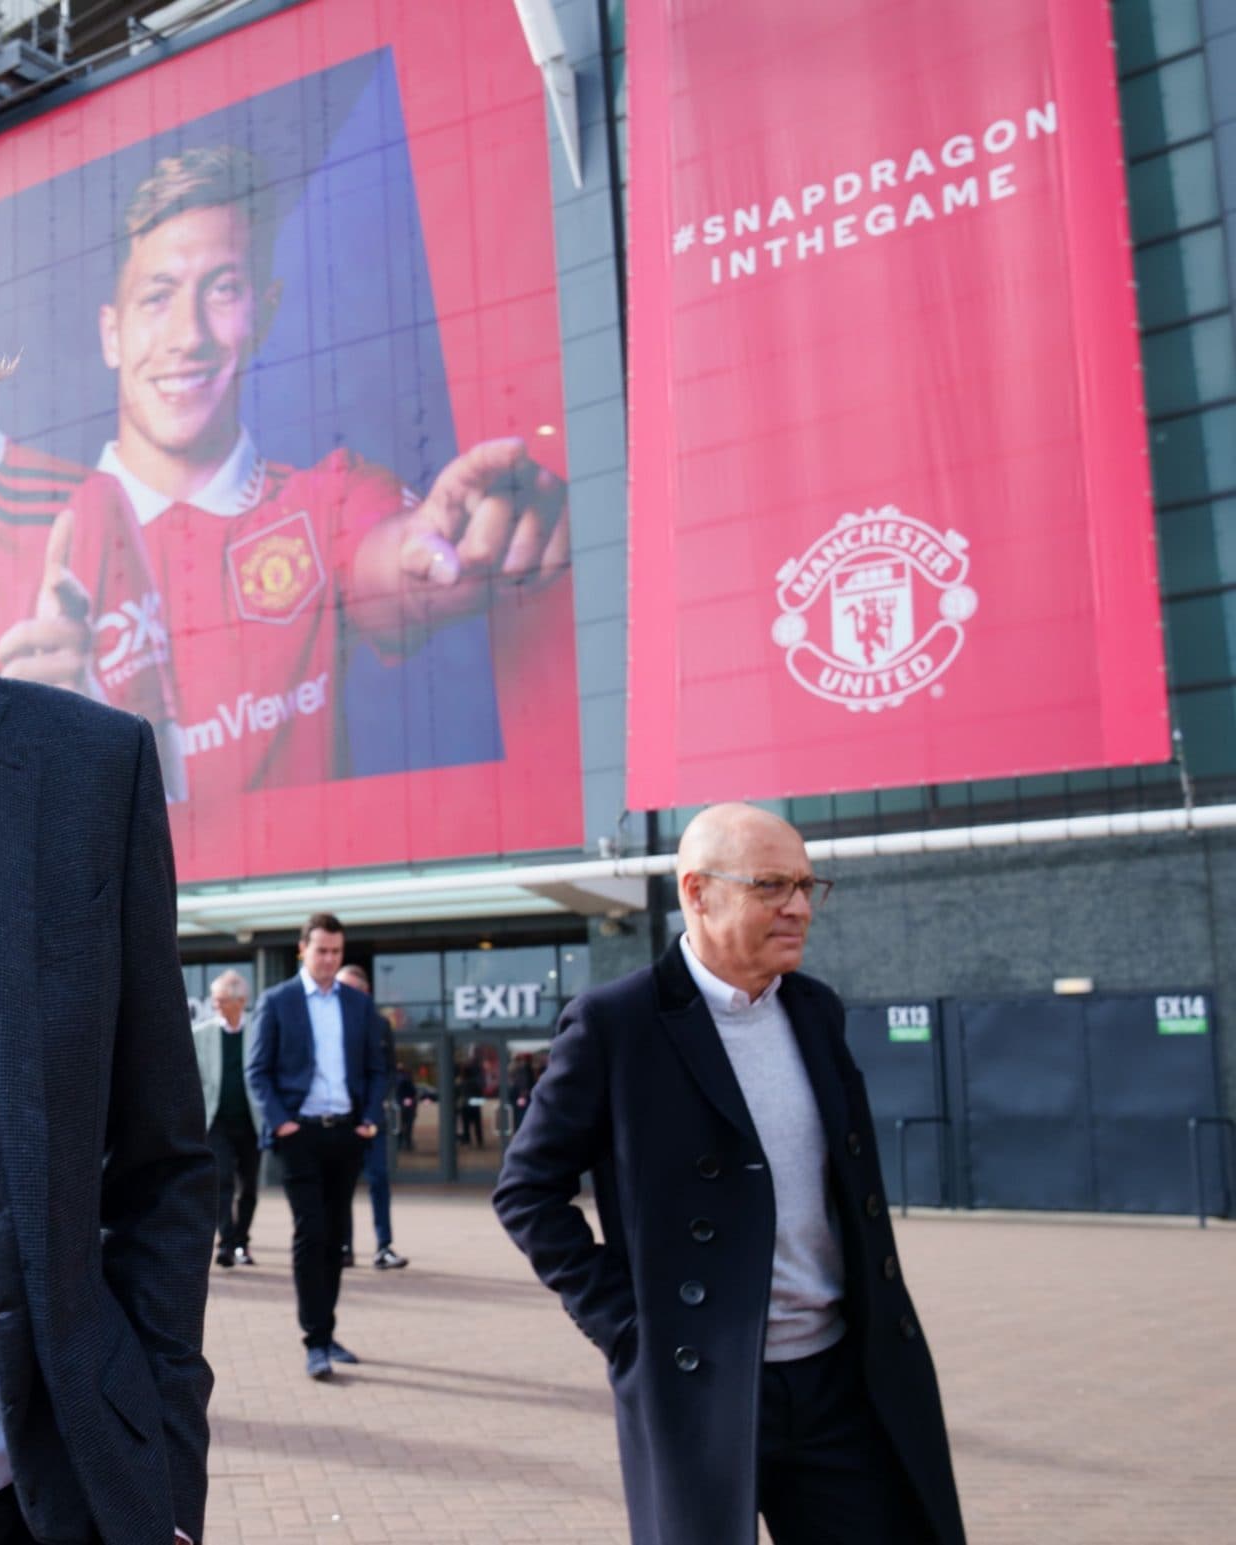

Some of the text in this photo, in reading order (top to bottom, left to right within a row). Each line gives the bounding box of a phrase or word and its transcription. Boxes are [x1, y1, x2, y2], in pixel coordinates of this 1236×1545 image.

[672, 101, 1059, 255] #SNAPDRAGON
[710, 163, 1018, 285] INTHEGAME
[790, 522, 954, 599] MANCHESTER
[817, 652, 935, 698] UNITED
[452, 982, 546, 1020] EXIT
[887, 1005, 930, 1028] EX13
[1155, 995, 1207, 1019] EX14
